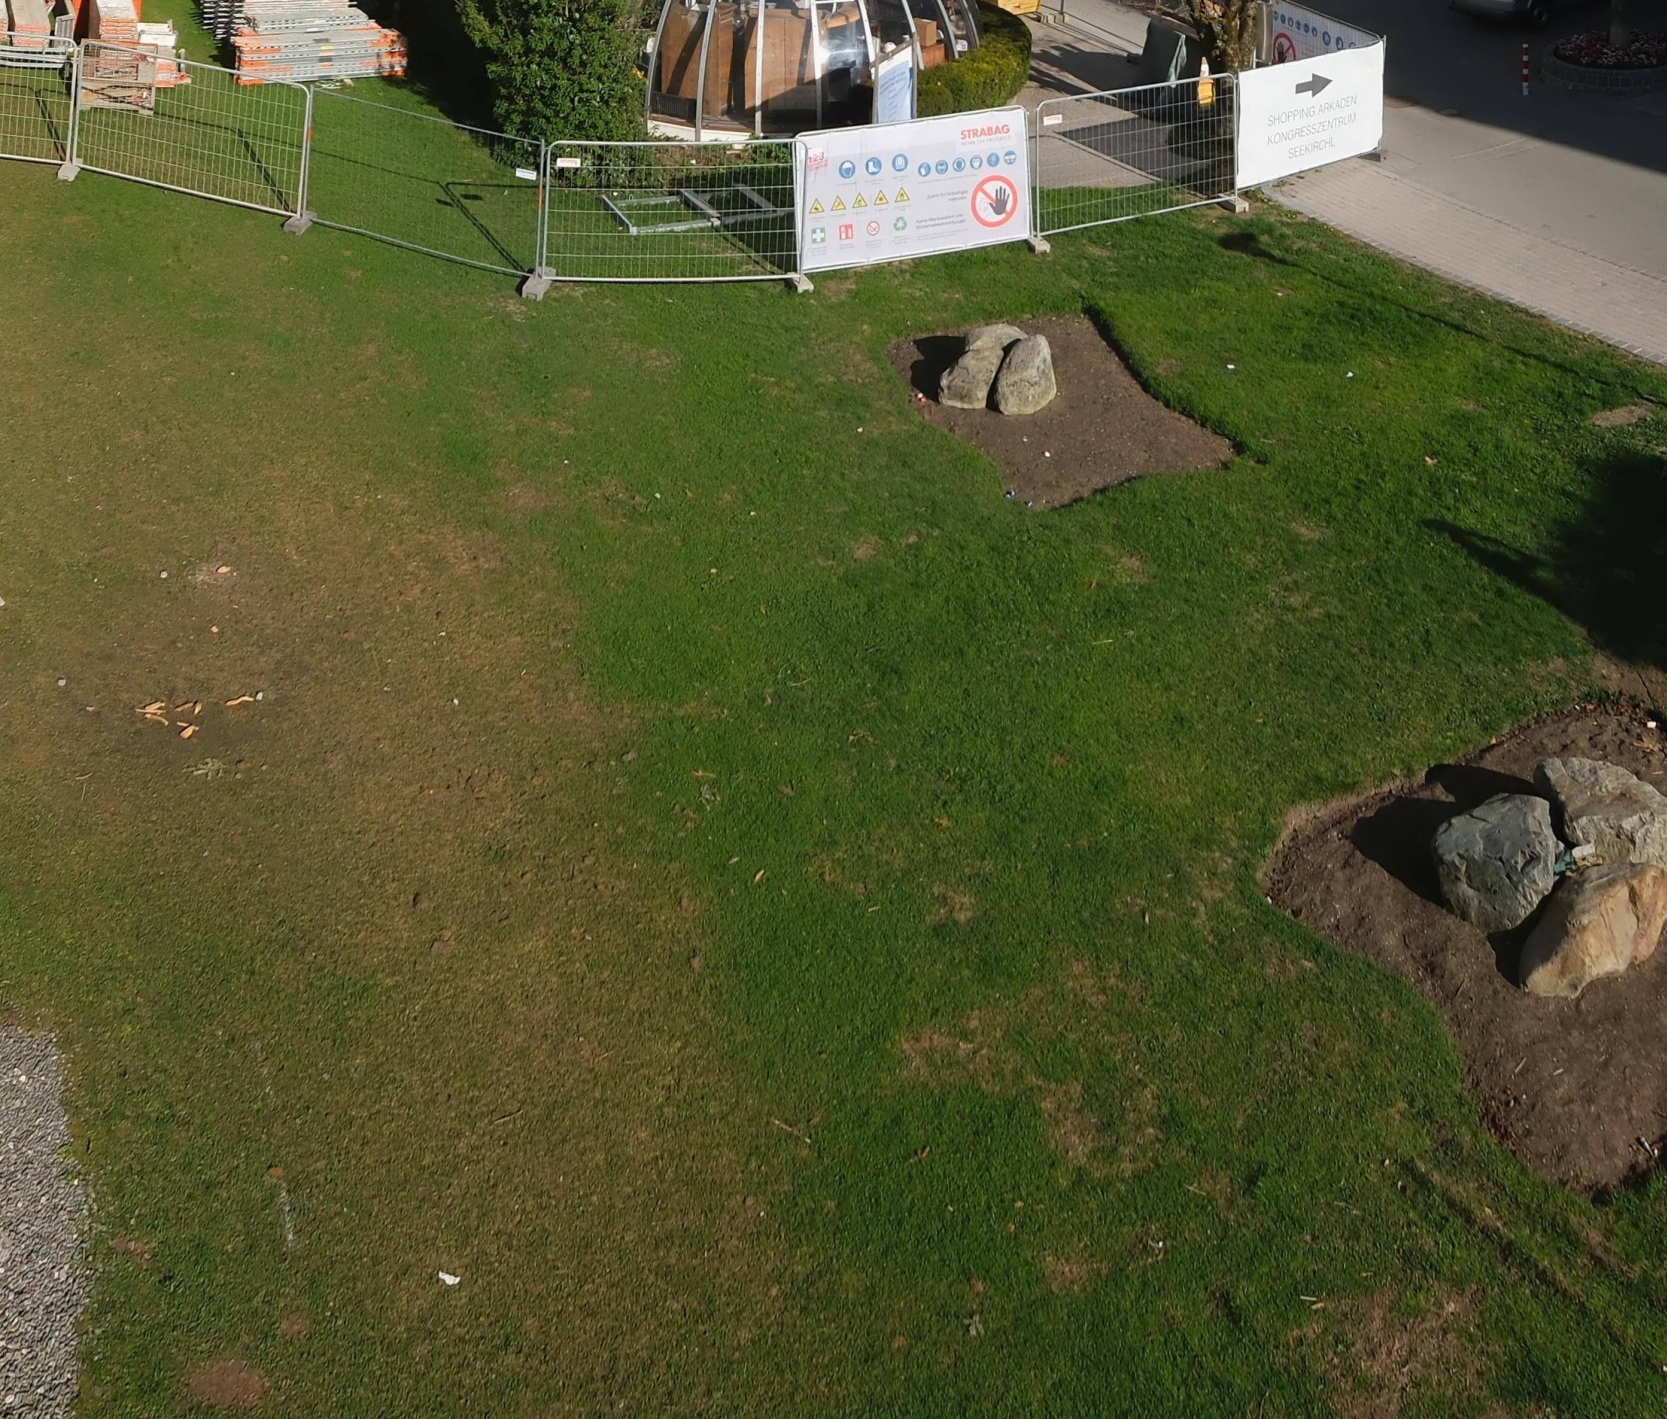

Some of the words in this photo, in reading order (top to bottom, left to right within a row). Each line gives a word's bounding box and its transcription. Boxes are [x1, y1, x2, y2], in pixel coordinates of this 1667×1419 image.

[1267, 106, 1316, 127] SHOPPING
[1318, 95, 1357, 115] ARKADEN
[960, 124, 1011, 140] STRABAG
[1267, 113, 1357, 146] KONGRESSZENTRUM
[1288, 137, 1336, 159] SEEKIRCHL
